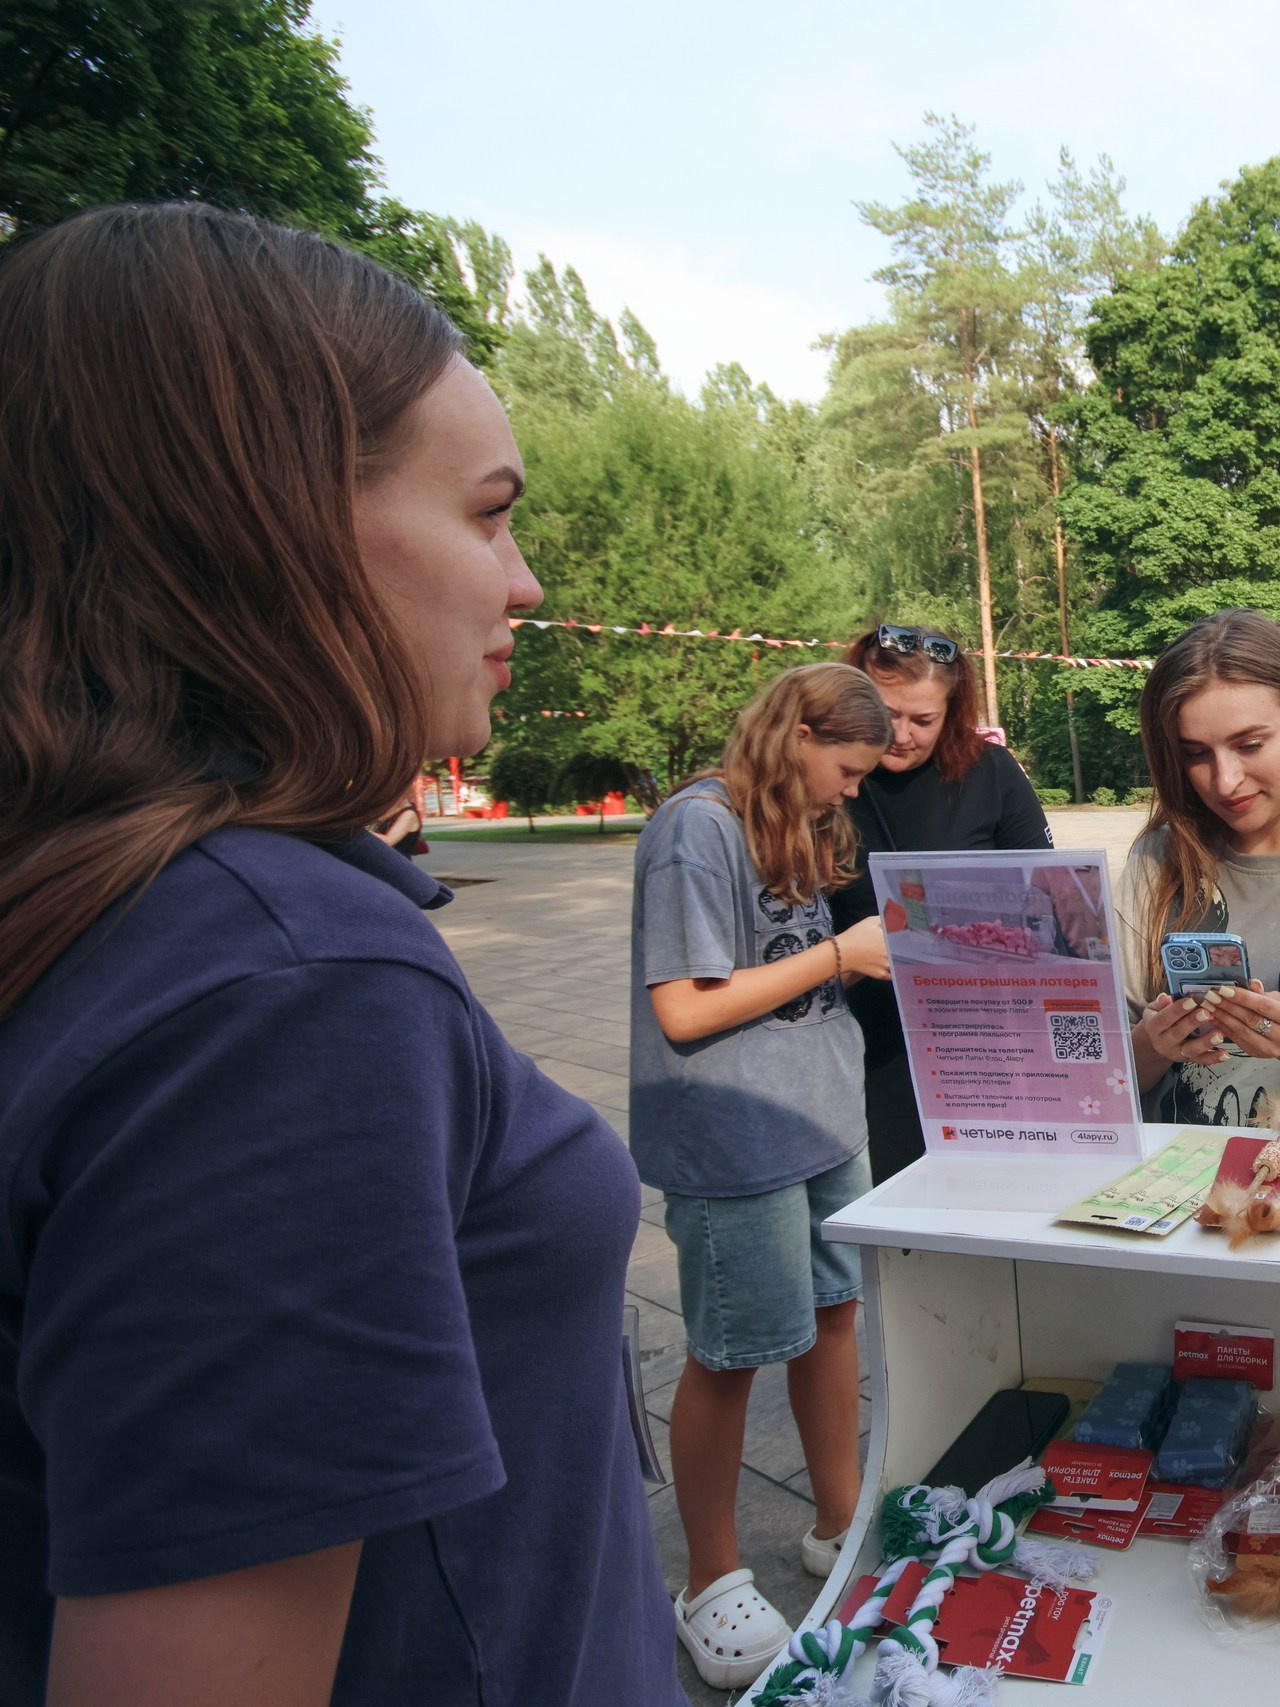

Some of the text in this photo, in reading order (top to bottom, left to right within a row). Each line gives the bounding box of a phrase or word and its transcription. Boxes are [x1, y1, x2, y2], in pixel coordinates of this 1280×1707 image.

[913, 975, 1098, 988] Беспроигрышная лотерея
[997, 1047, 1034, 1055] телеграм
[979, 1070, 1014, 1078] подписку
[944, 1093, 980, 1101] Вытащите
[1077, 1132, 1113, 1142] 4lapy.ru
[1178, 1350, 1209, 1360] petmax
[1217, 1346, 1250, 1356] ПАКЕТЫ
[1216, 1354, 1268, 1366] ДЛЯ УБОРКИ
[1047, 1465, 1102, 1477] ДЛЯ УБОРКИ
[1109, 1471, 1143, 1480] petmax
[1062, 1476, 1099, 1485] ПАКЕТЫ
[1096, 1534, 1125, 1544] petmax
[1058, 1591, 1069, 1606] DOG
[1051, 1607, 1063, 1621] TOY
[996, 1585, 1041, 1663] petmax
